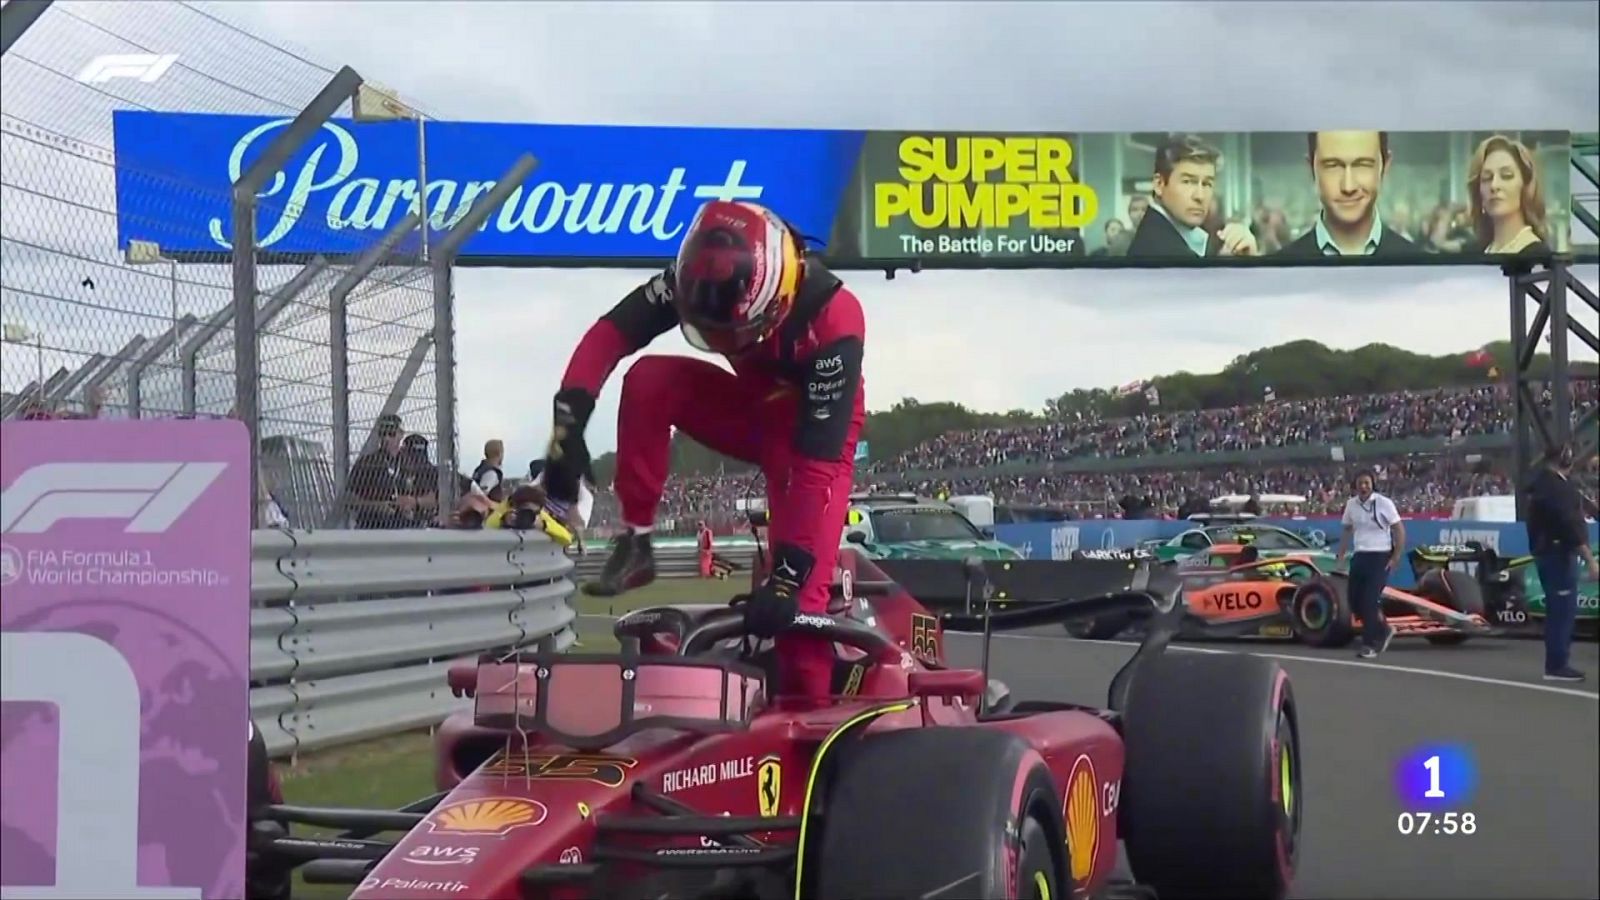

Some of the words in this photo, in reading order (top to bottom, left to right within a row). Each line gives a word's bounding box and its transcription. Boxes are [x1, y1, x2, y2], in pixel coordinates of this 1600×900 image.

[898, 136, 1074, 182] SUPER
[875, 182, 1098, 229] PUMPED
[899, 235, 934, 253] The
[938, 235, 993, 253] Battle
[998, 236, 1027, 253] For
[1031, 236, 1075, 254] Uber
[815, 355, 843, 370] aws
[27, 550, 58, 566] FIA
[63, 550, 140, 566] Formula
[144, 551, 153, 566] 1
[27, 568, 82, 584] World
[87, 568, 219, 586] Championship
[1213, 591, 1262, 611] VELO
[1497, 610, 1526, 623] VELO
[663, 763, 717, 794] RICHARD
[720, 756, 755, 780] MILLE
[409, 845, 481, 858] aws
[381, 877, 470, 893] Palantir
